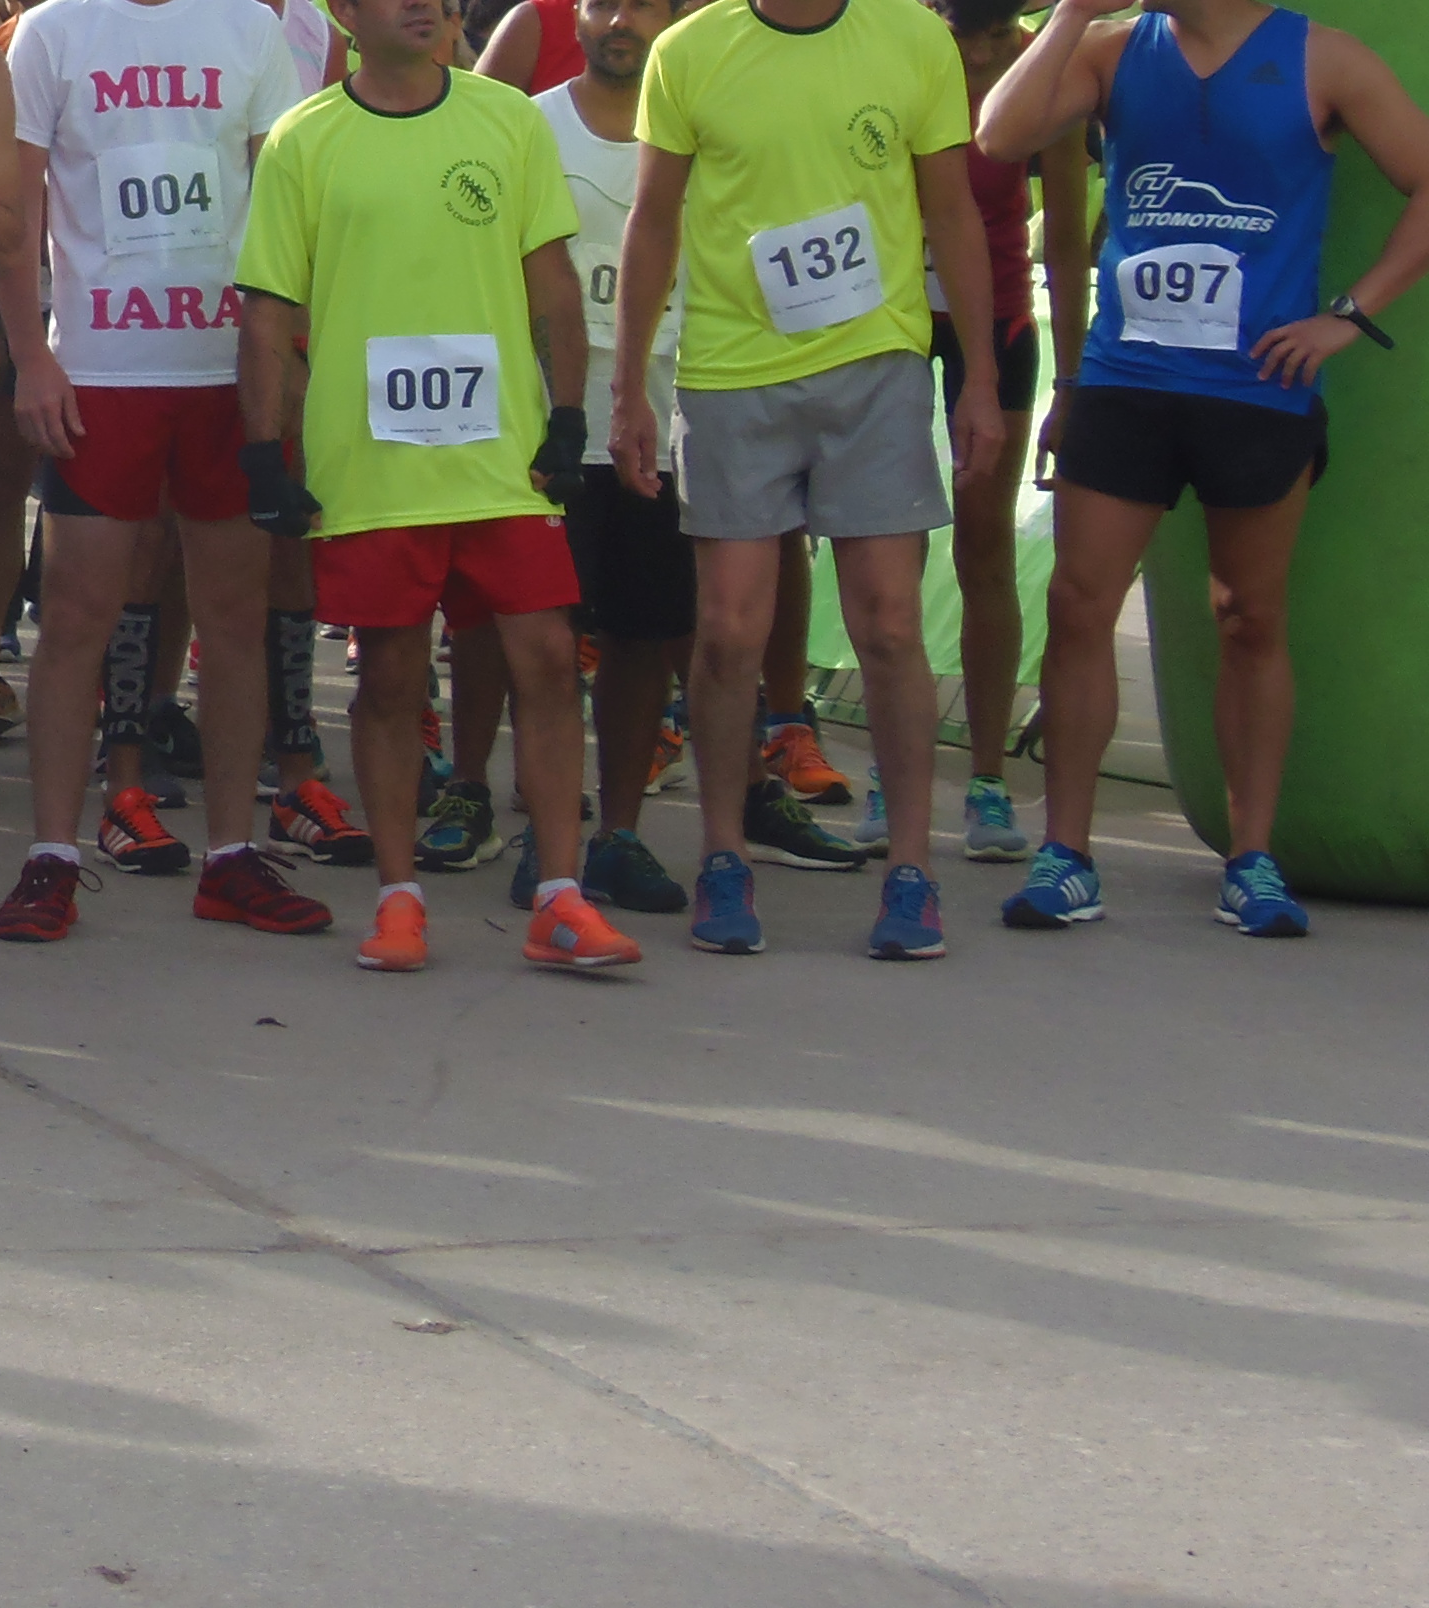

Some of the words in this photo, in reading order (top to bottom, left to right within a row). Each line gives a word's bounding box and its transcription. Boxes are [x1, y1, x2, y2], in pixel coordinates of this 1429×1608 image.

[89, 65, 223, 113] MILI
[118, 172, 211, 220] 004
[1126, 211, 1275, 233] AUTOMOTORES
[767, 224, 867, 288] 132
[1133, 259, 1231, 306] 097
[89, 286, 242, 330] IARA
[385, 365, 485, 411] 007
